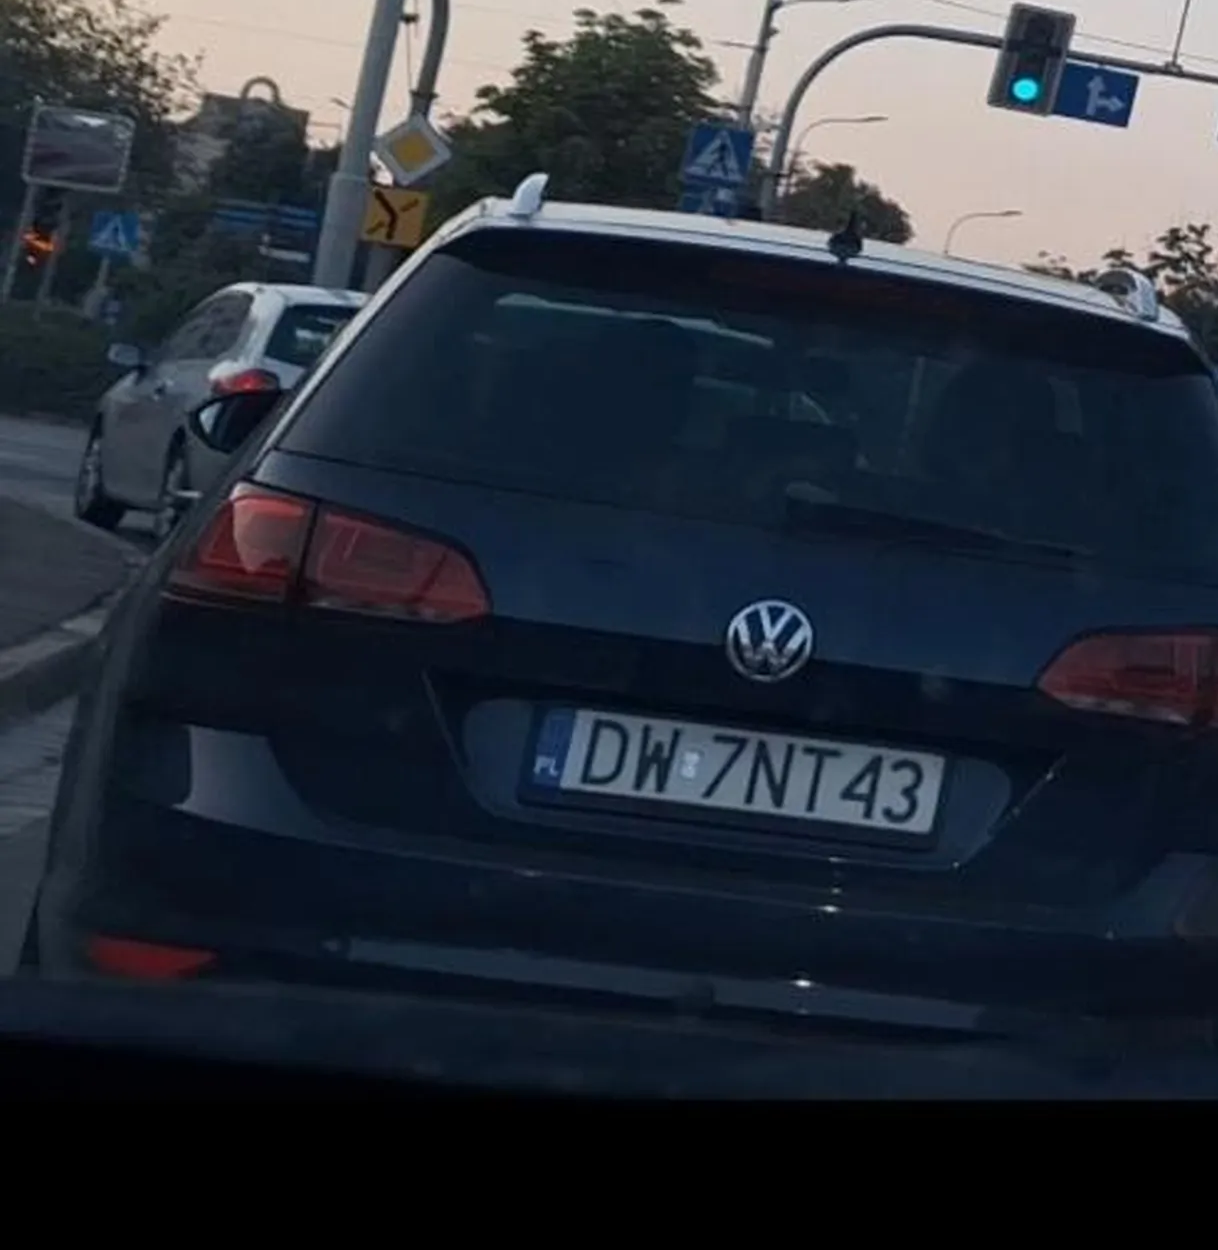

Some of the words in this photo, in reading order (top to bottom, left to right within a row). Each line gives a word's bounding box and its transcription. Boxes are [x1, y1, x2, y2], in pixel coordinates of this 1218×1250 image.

[534, 756, 561, 777] PL
[580, 718, 685, 793] DW
[701, 734, 925, 823] 7NT43
